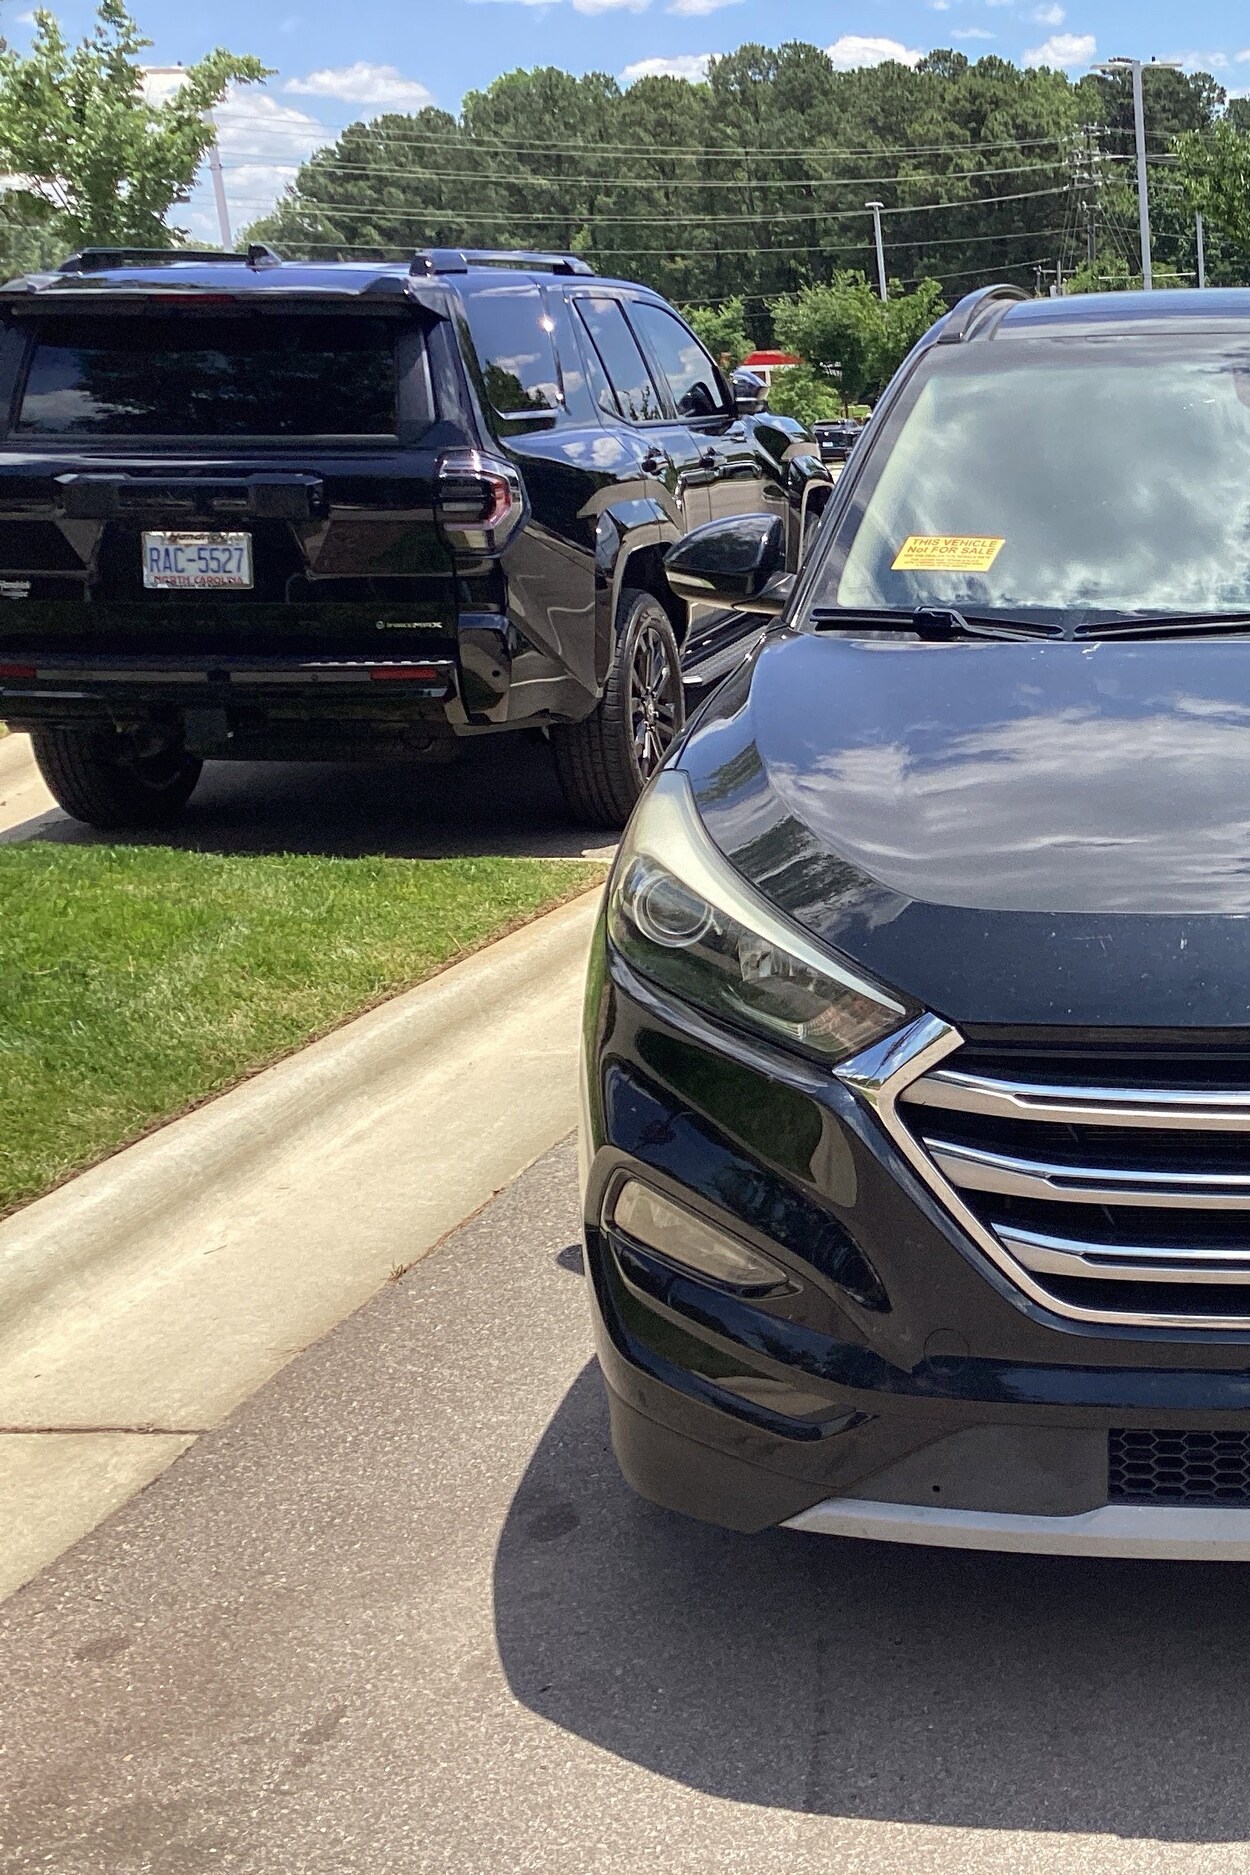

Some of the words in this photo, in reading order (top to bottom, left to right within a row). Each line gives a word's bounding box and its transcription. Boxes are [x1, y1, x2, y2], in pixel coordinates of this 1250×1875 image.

[912, 538, 940, 546] THIS
[943, 539, 998, 548] VEHICLE
[907, 546, 929, 554] Not
[931, 546, 958, 554] FOR
[960, 547, 996, 555] SALE
[148, 547, 244, 574] RAC-5527
[154, 575, 190, 586] NORTH
[194, 575, 243, 586] CAROLINA
